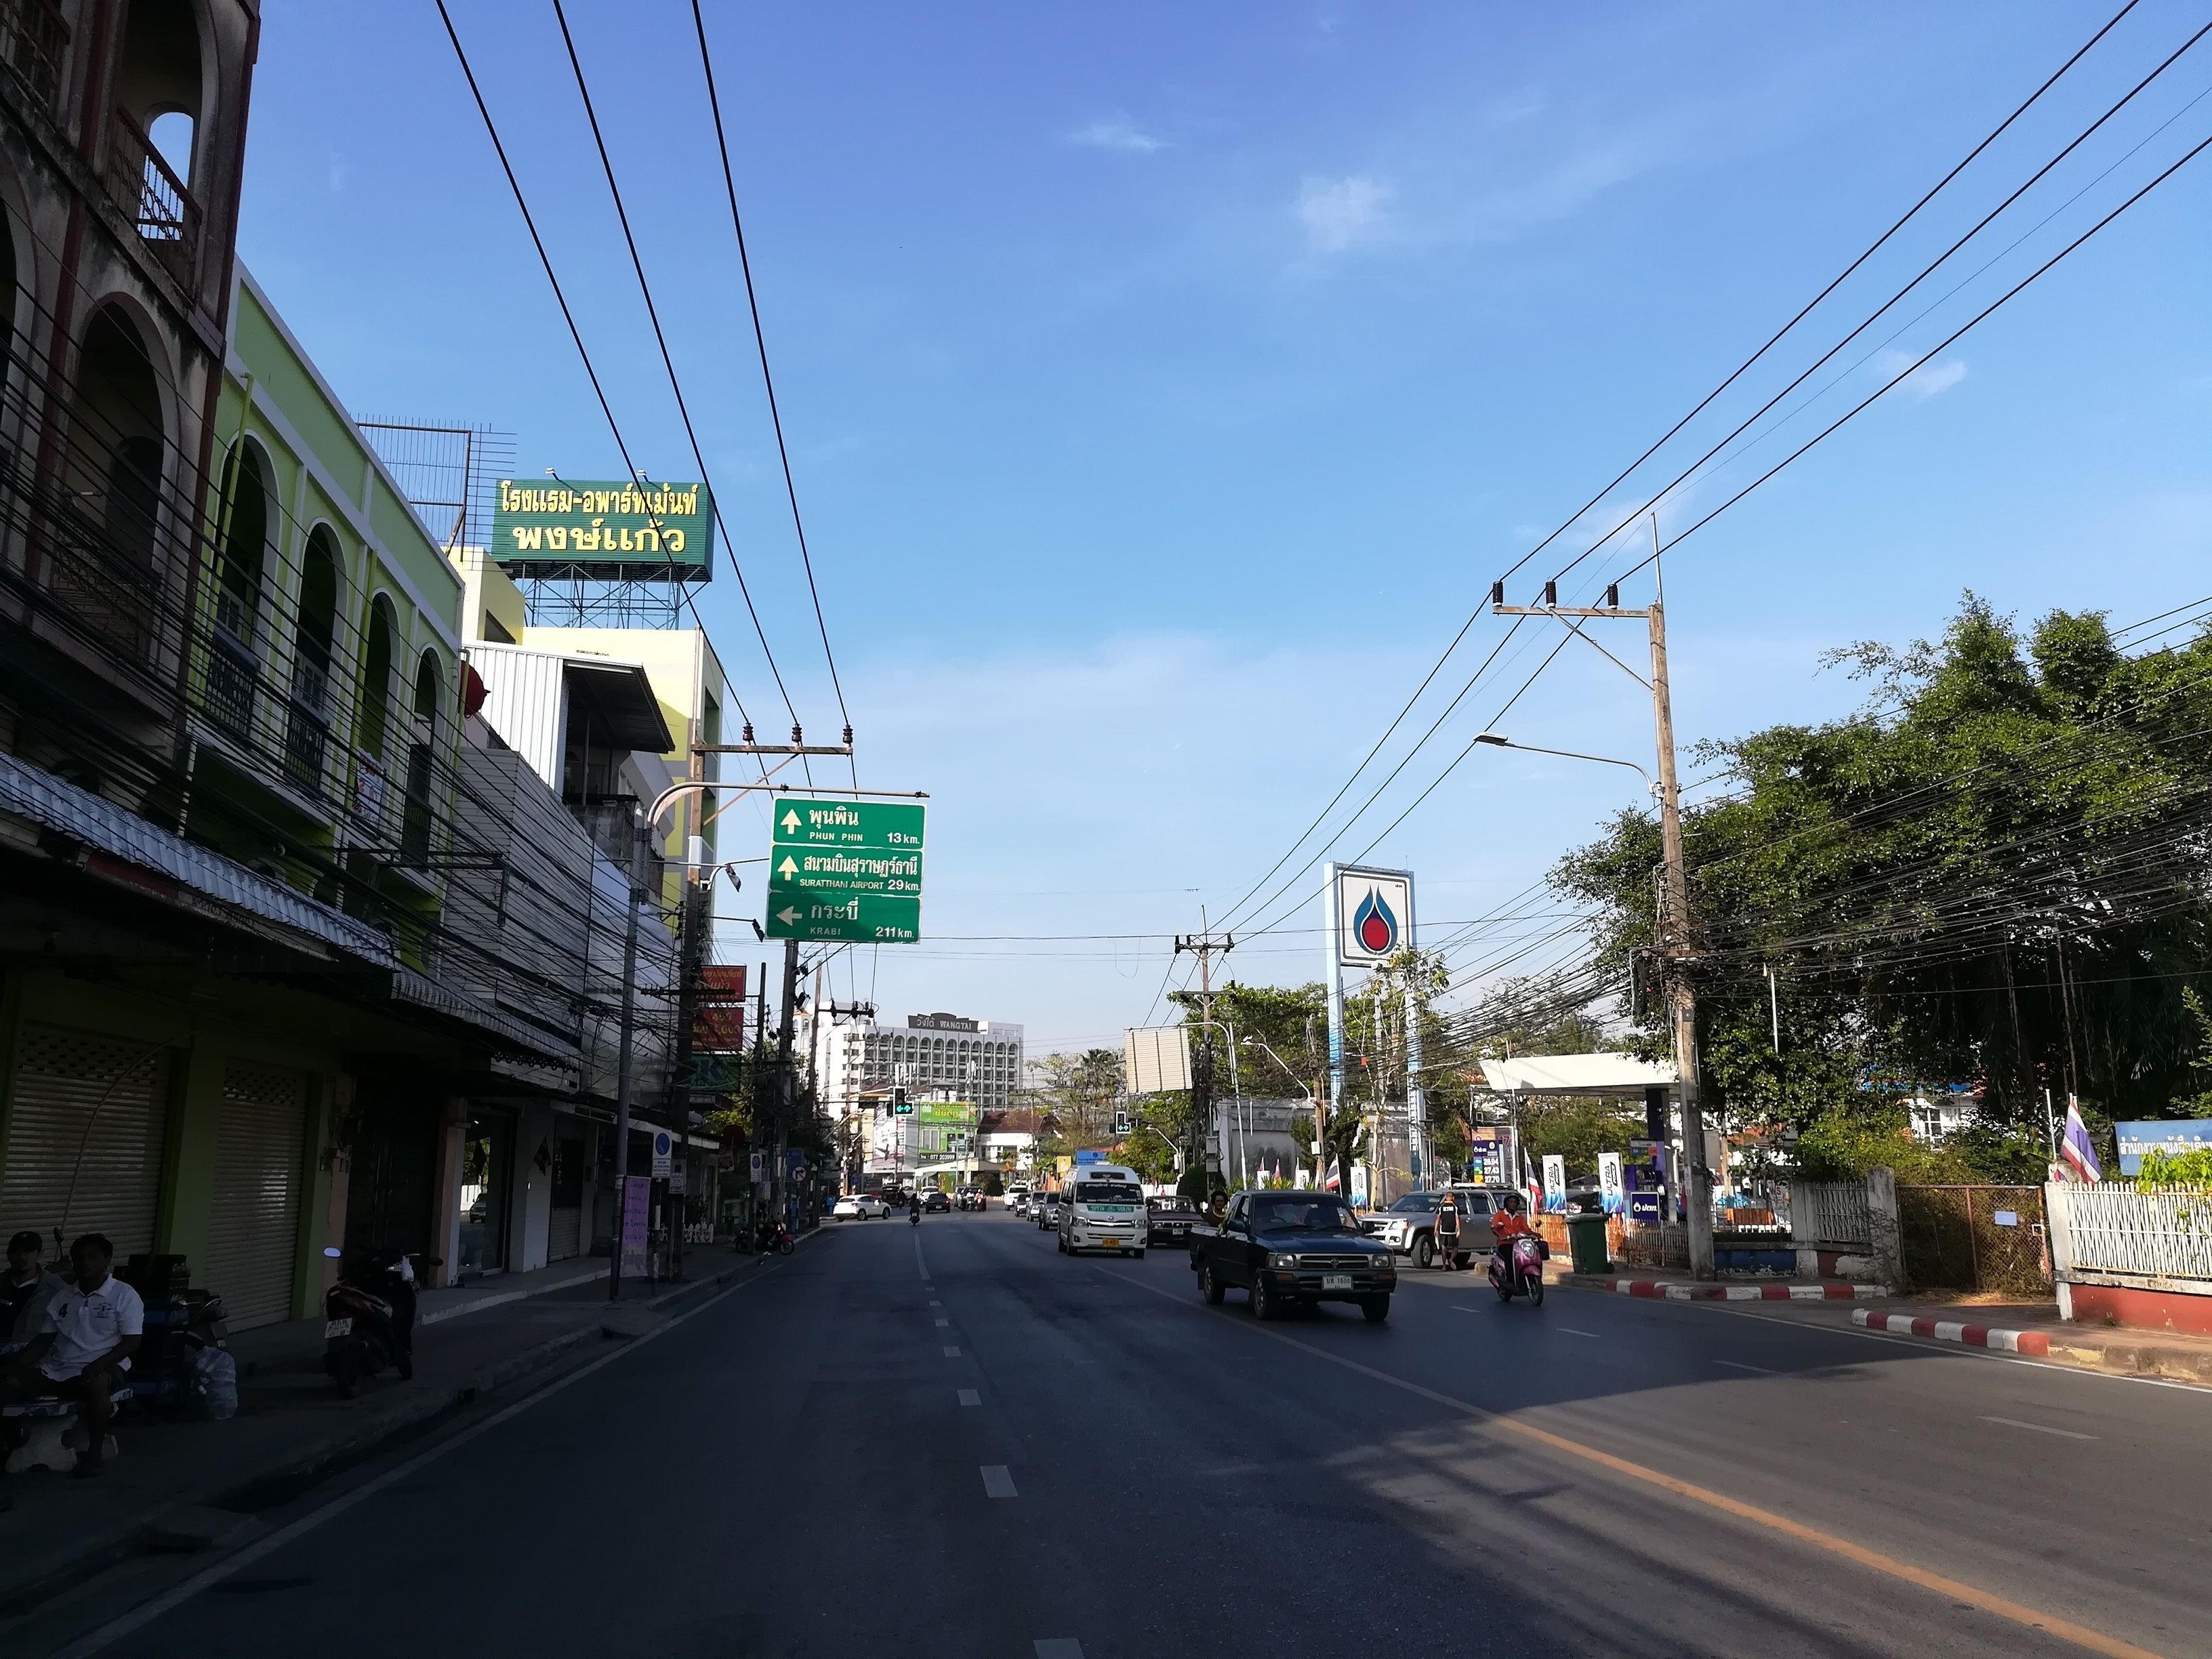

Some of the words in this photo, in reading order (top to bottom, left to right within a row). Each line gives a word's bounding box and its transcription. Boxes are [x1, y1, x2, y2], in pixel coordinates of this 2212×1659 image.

[512, 518, 686, 552] พงษ์แก้ว
[808, 806, 859, 829] พุนพิน
[809, 832, 835, 840] PHUN
[842, 833, 863, 842] PHIN
[887, 832, 902, 844] 13
[903, 834, 920, 844] km.
[804, 853, 917, 878] สนามบินสุราษฎร์ธานี
[800, 878, 848, 888] SURATTHANI
[850, 880, 884, 889] AIRPORT
[887, 880, 903, 890] 29
[905, 881, 920, 891] km.
[811, 897, 859, 920] กระบี่
[811, 926, 841, 935] KRABI
[876, 926, 895, 937] 211
[916, 1016, 935, 1027] วังใต้
[940, 1020, 972, 1030] WANGTAI
[1605, 1165, 1613, 1196] ULTRA
[58, 1303, 68, 1318] 4
